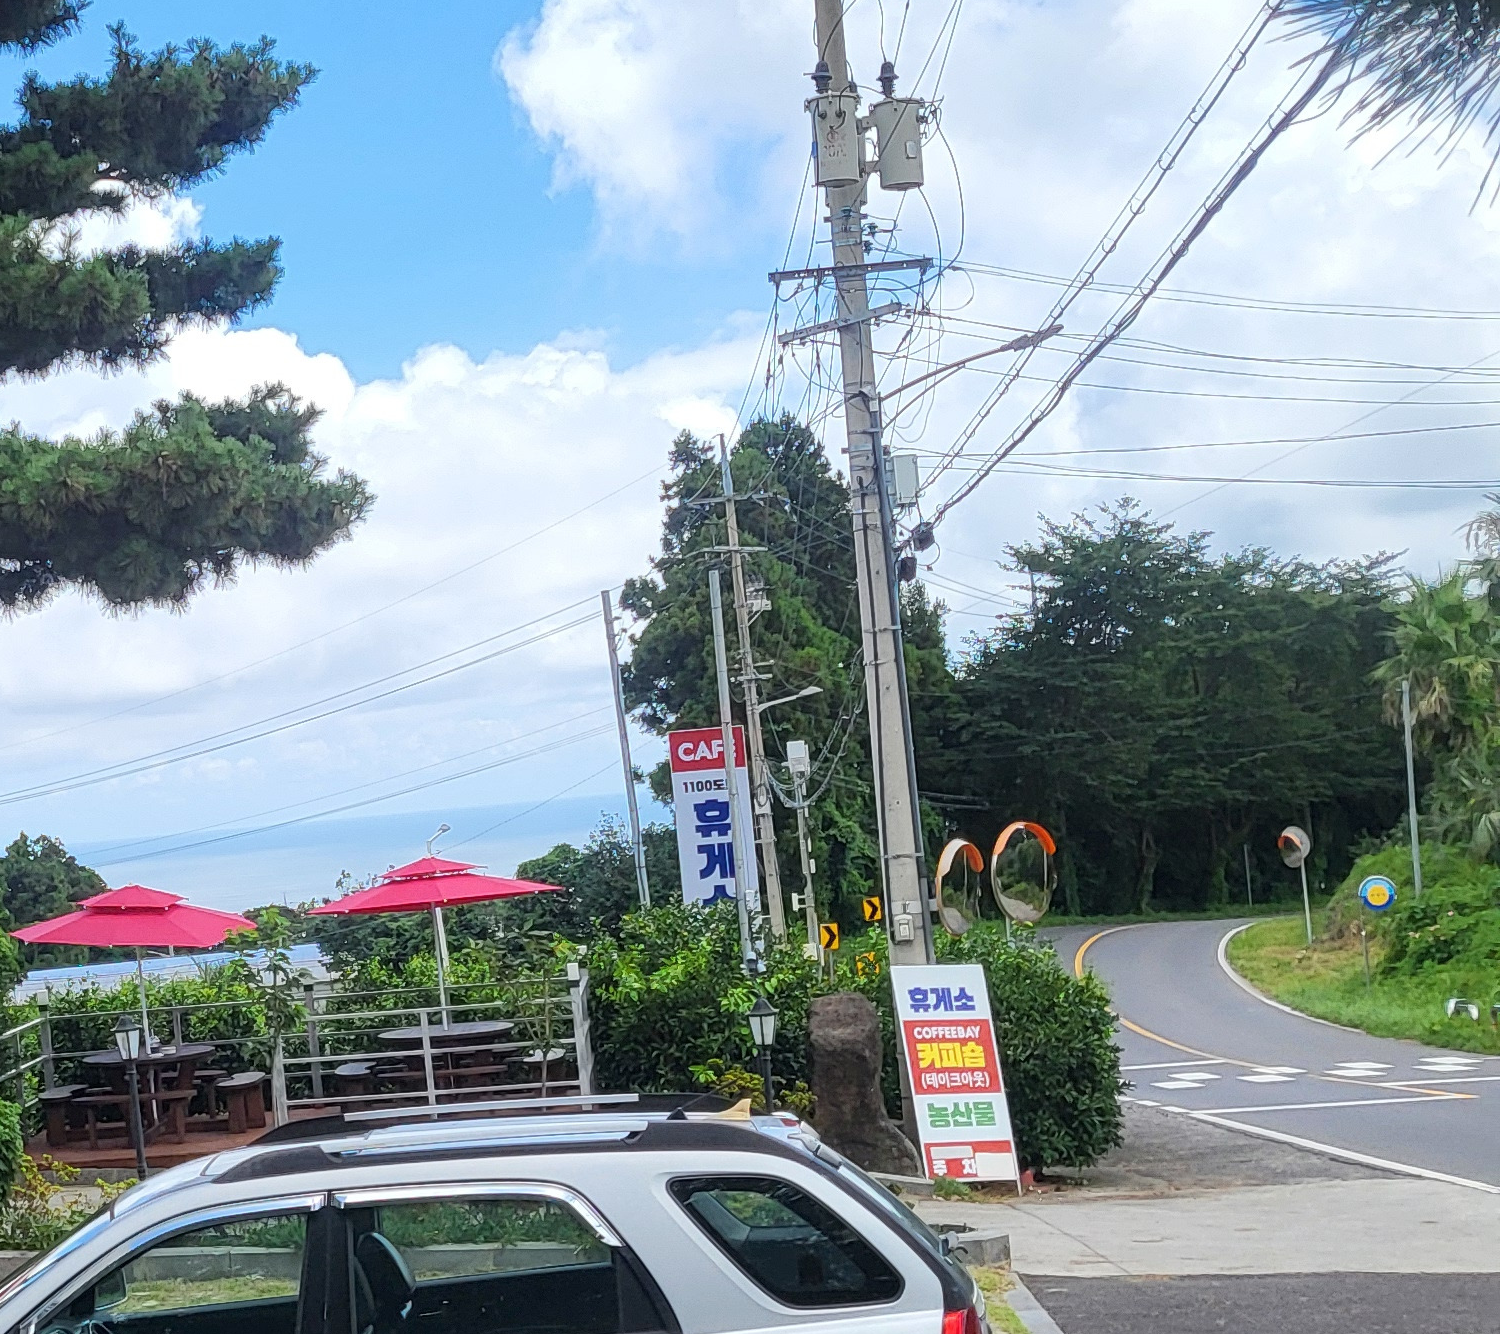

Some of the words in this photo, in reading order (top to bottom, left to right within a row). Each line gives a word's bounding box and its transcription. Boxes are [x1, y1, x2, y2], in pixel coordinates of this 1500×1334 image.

[677, 739, 736, 762] CAF
[682, 778, 729, 793] 1100도
[907, 987, 976, 1013] 휴게소
[913, 1026, 980, 1040] COFFEEBAY
[915, 1041, 986, 1069] 커피숍
[921, 1071, 991, 1089] (테이크아웃)
[927, 1101, 996, 1128] 농산물
